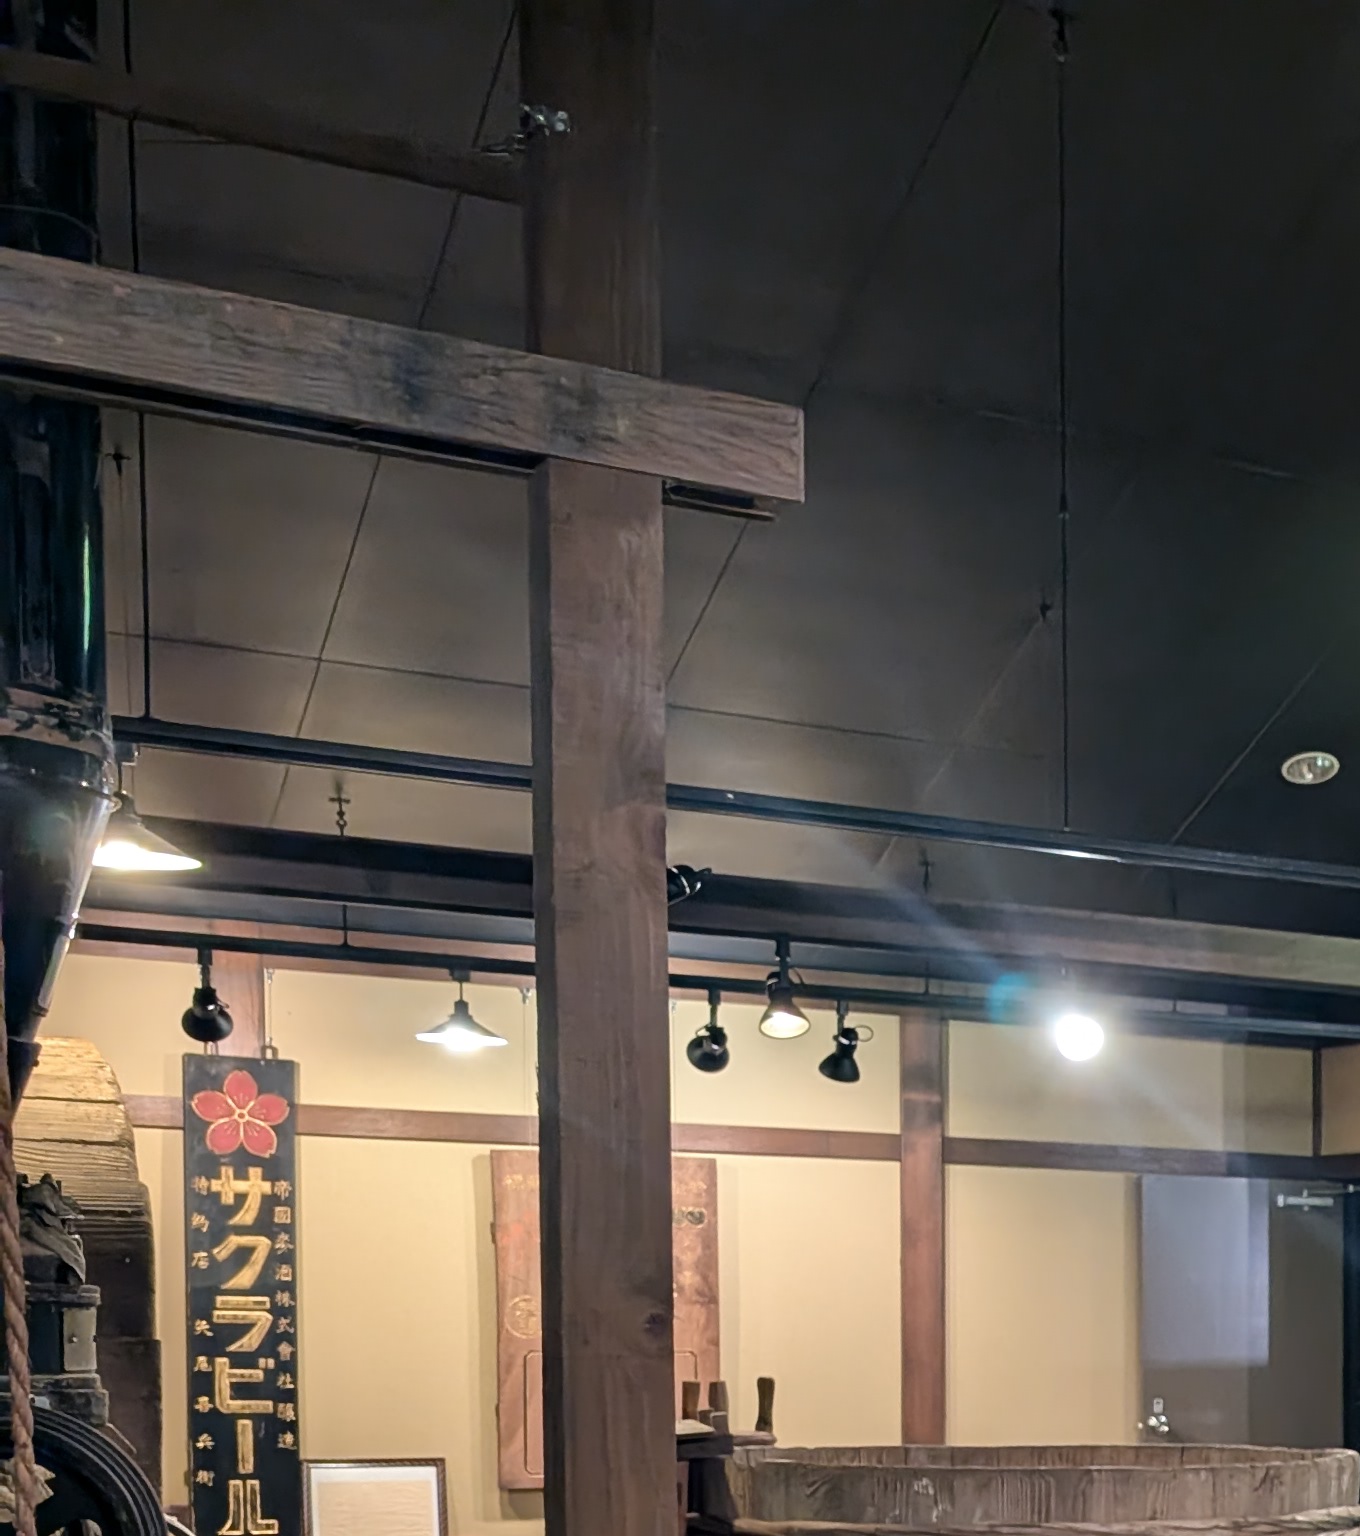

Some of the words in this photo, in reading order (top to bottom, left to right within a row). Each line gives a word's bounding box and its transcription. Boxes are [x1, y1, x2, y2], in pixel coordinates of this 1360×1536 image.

[211, 1166, 278, 1535] サクラビール
